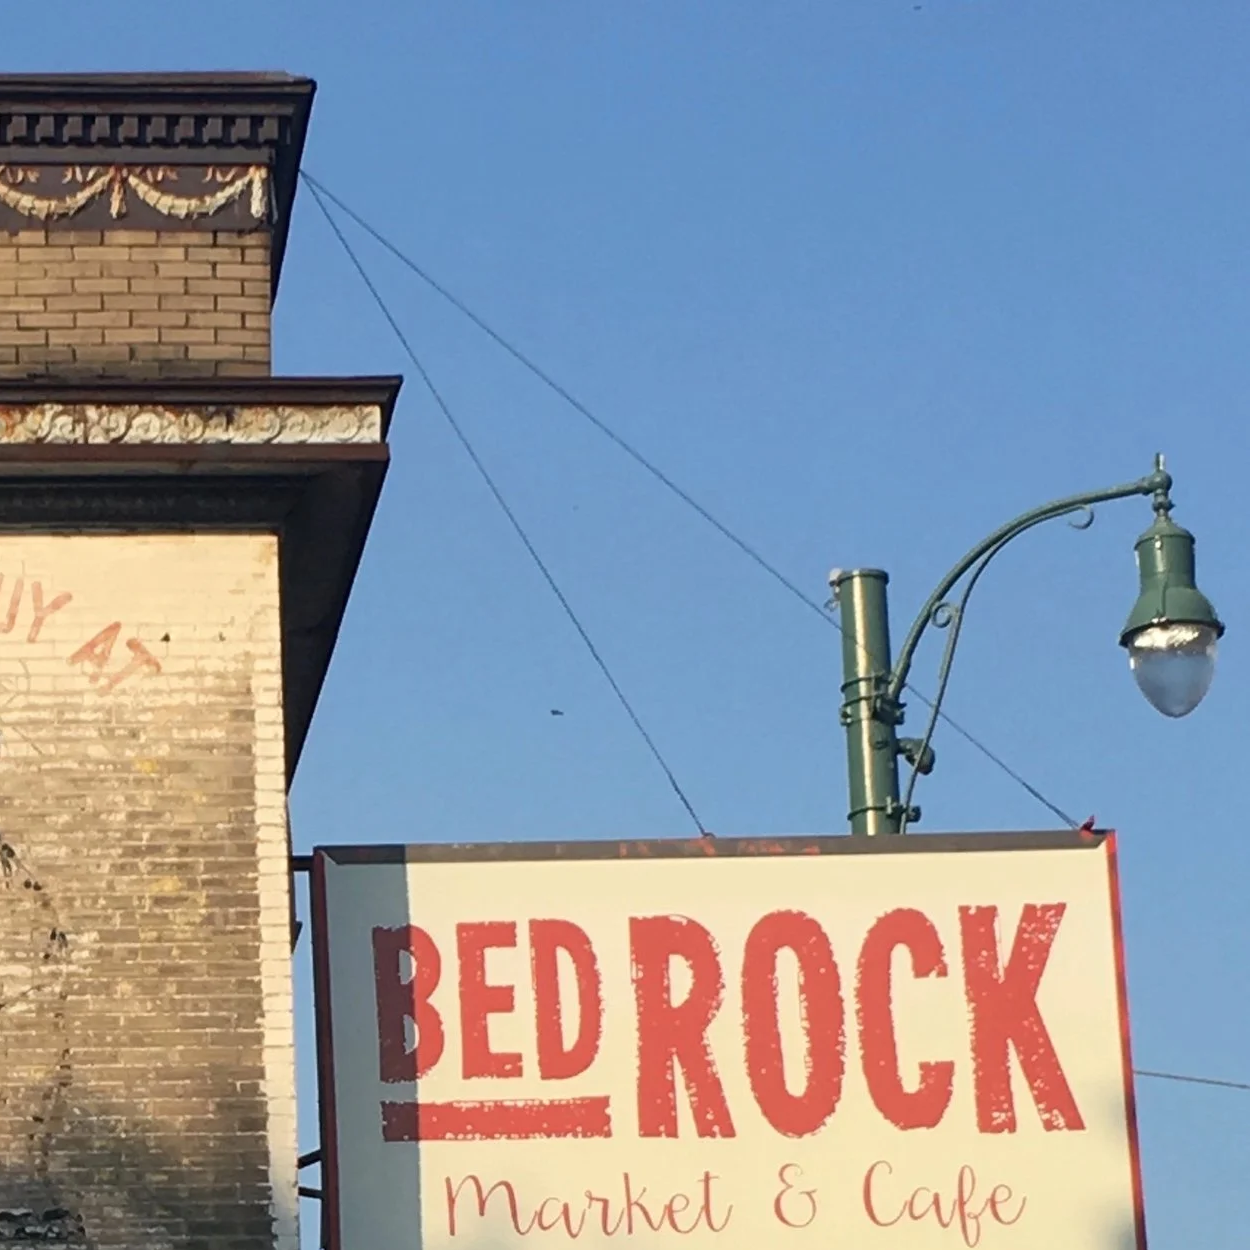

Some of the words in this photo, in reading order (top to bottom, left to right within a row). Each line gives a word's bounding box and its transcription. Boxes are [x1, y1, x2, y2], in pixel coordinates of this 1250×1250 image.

[67, 621, 162, 697] AT
[444, 1169, 733, 1239] Market
[773, 1161, 818, 1228] &
[861, 1159, 1028, 1248] Cafe
